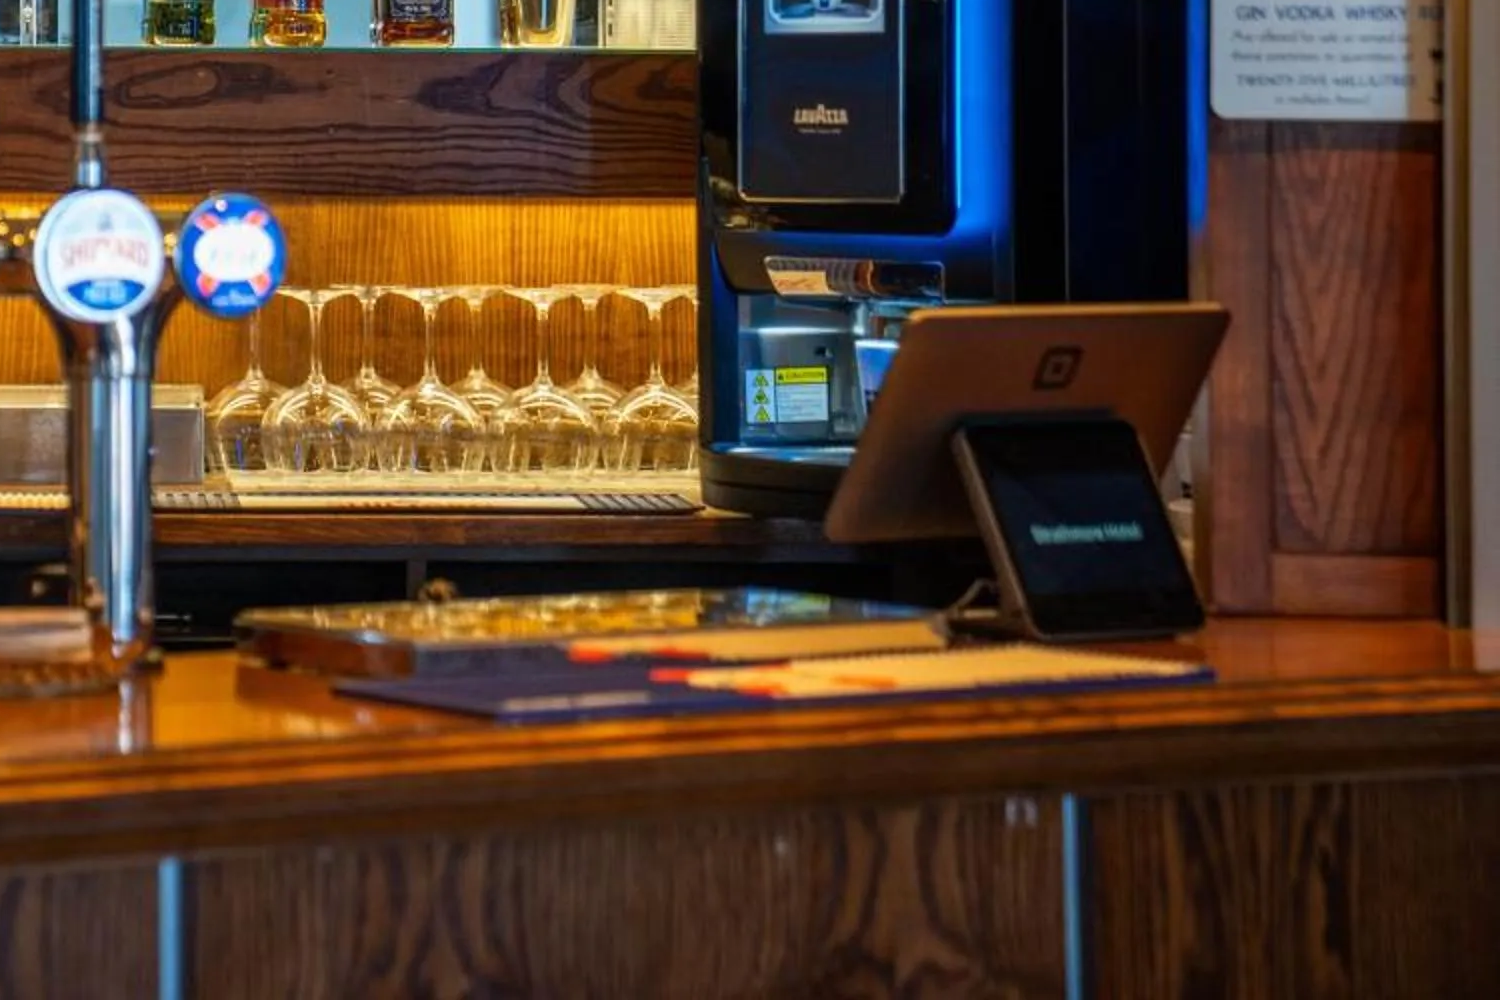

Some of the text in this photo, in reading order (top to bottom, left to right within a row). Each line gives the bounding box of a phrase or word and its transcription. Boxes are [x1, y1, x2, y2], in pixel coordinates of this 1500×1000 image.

[1235, 4, 1267, 21] GIN
[1274, 4, 1336, 21] VODKA
[1344, 4, 1408, 21] WHISKY
[793, 104, 849, 125] LAVAZZA
